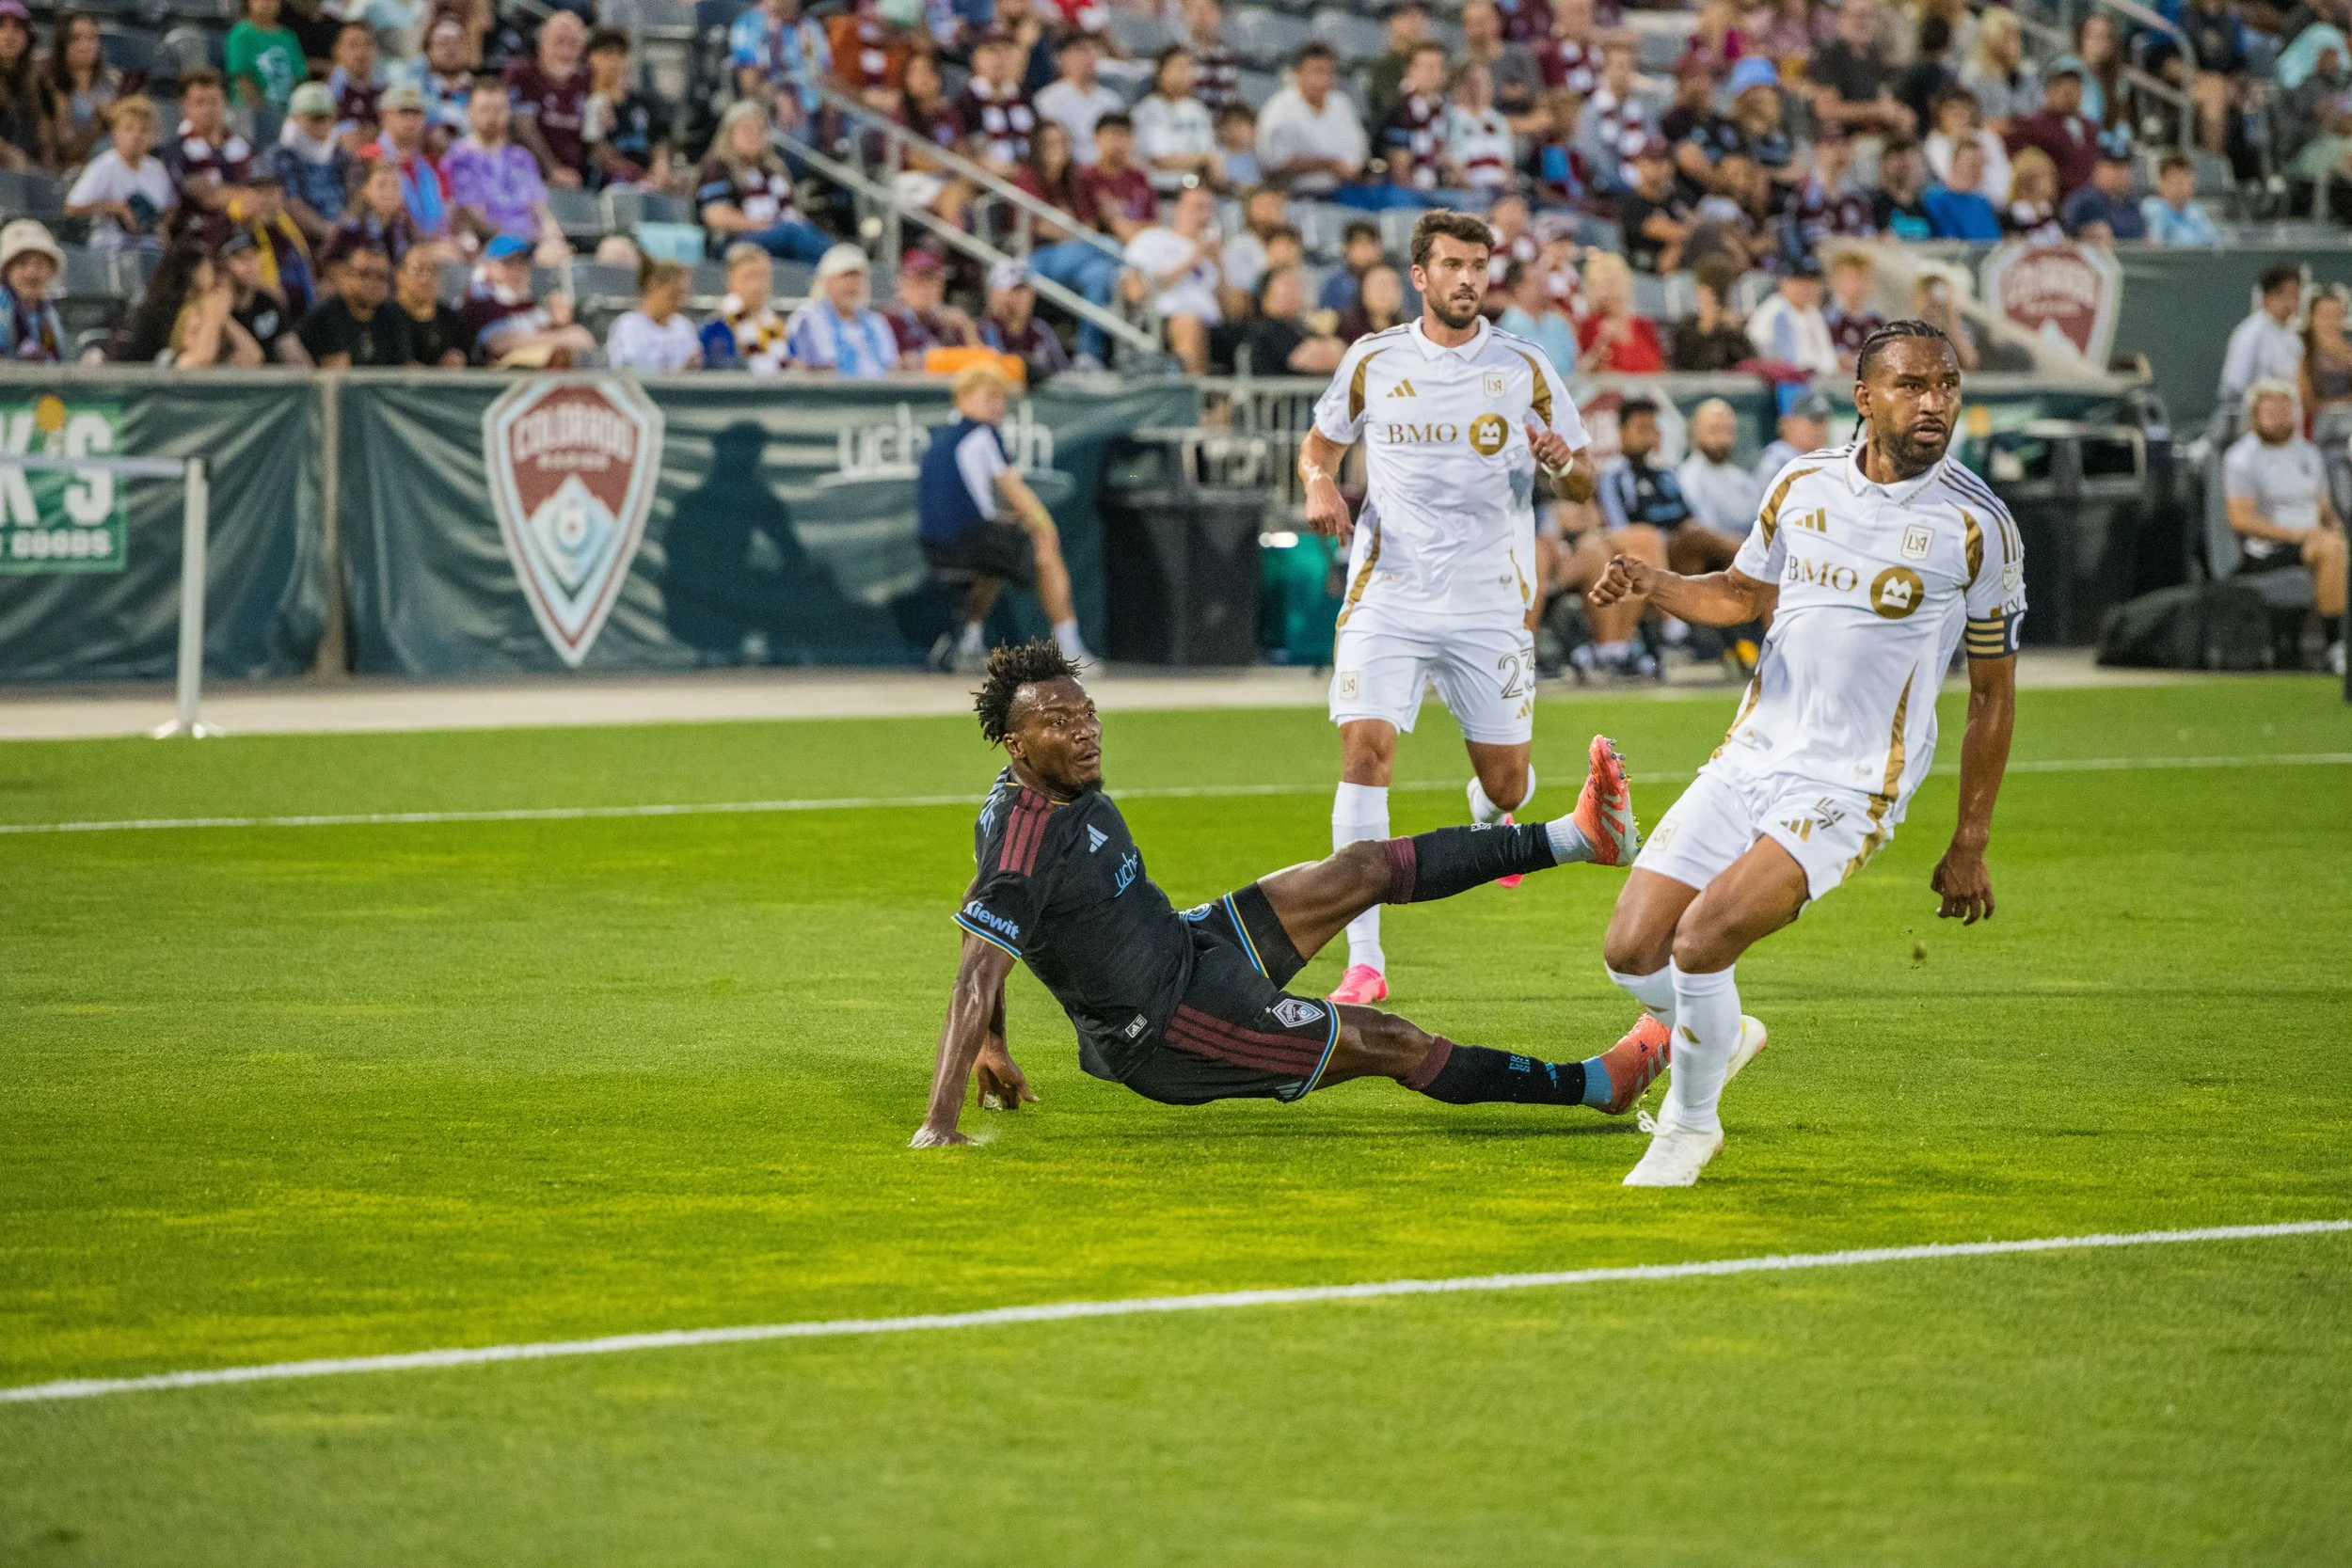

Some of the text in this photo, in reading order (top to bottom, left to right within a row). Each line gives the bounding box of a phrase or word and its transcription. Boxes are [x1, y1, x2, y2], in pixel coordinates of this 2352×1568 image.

[1388, 423, 1457, 444] BMO
[1787, 555, 1858, 593] BMO
[1498, 646, 1536, 699] 23
[962, 900, 1019, 940] Kiewit
